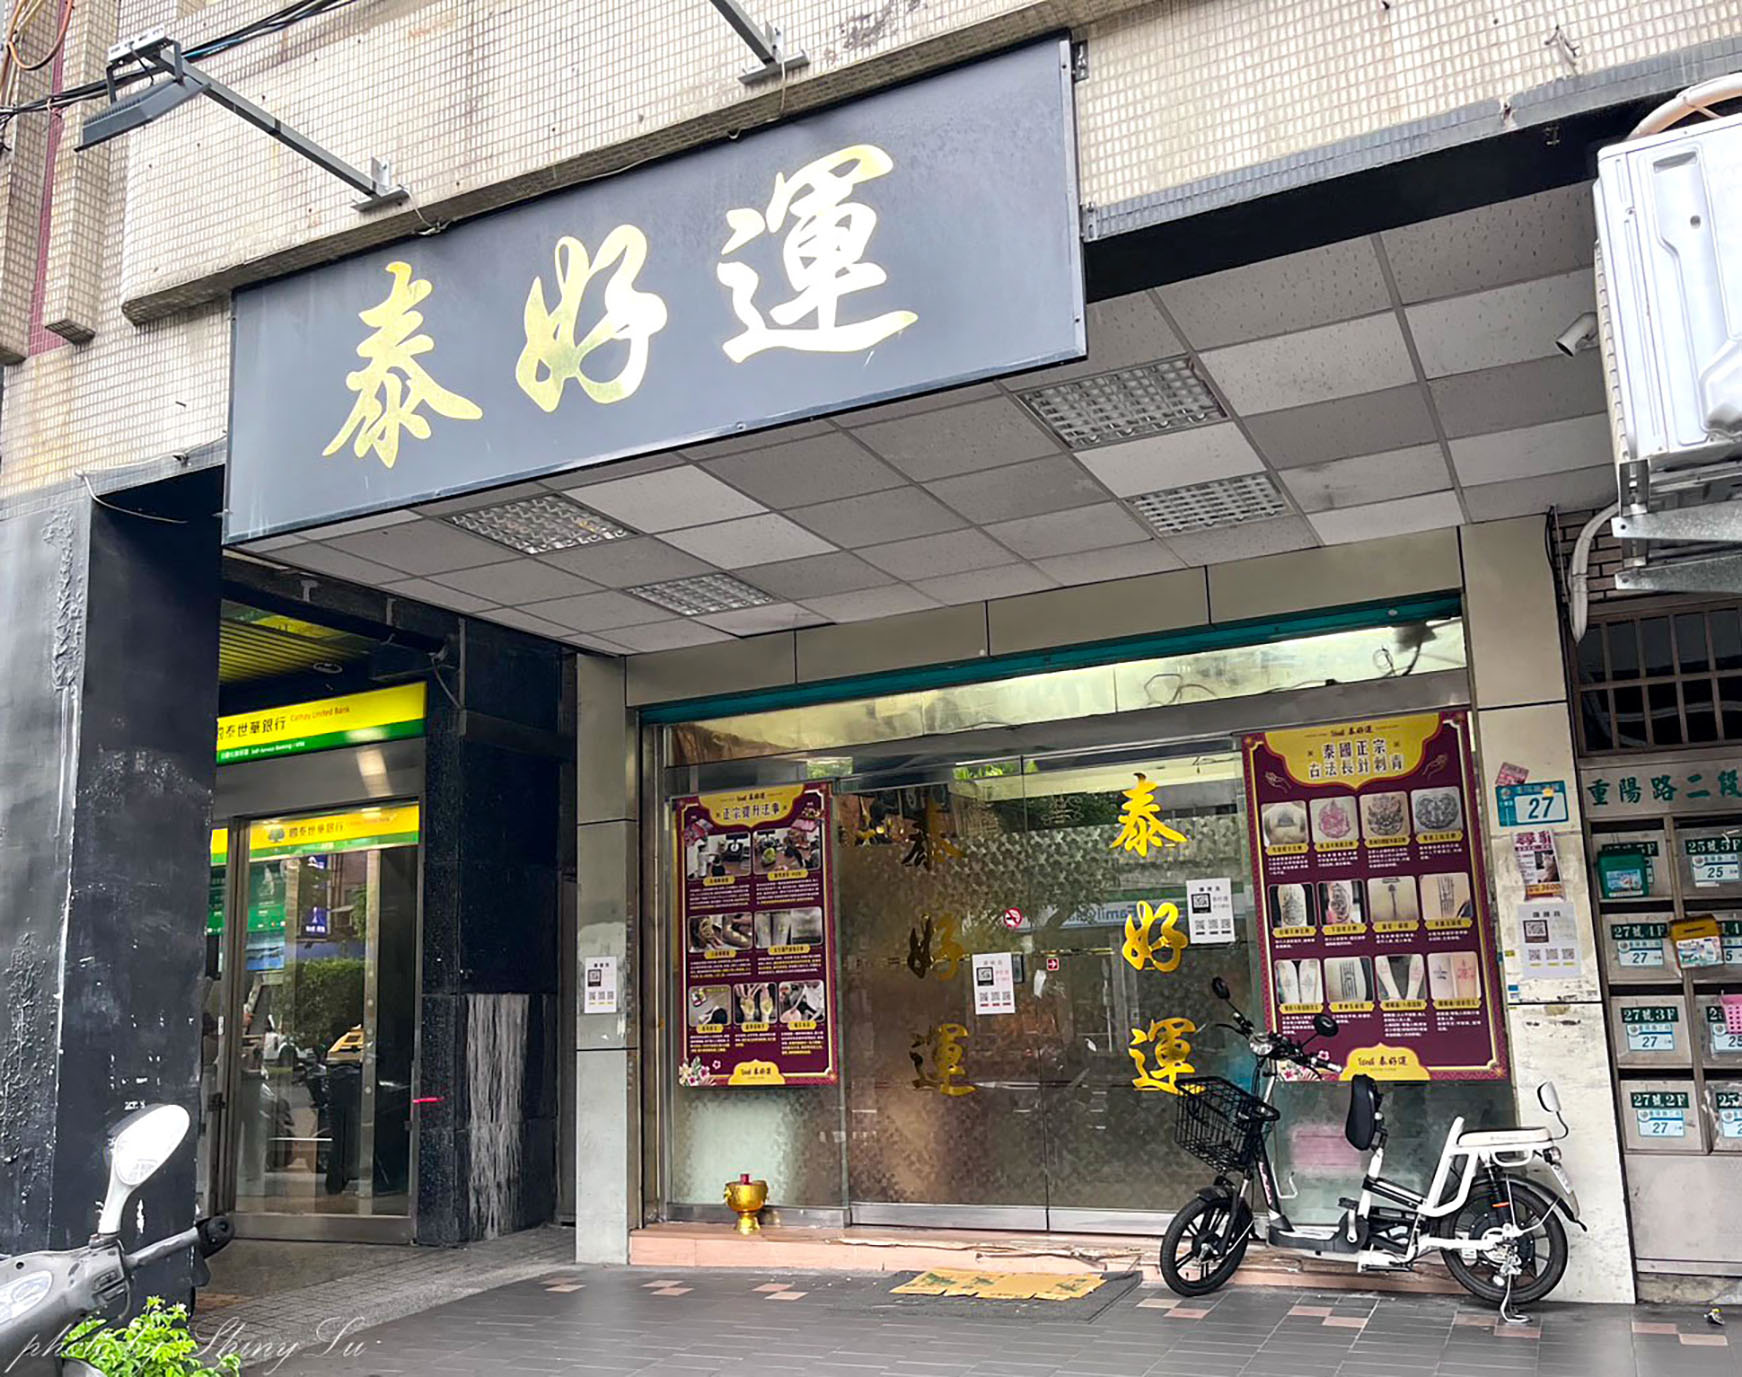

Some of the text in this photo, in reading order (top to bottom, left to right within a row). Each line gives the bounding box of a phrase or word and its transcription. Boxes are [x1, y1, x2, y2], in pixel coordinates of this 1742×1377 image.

[323, 145, 918, 469] 泰好運
[334, 705, 350, 716] Bank
[1324, 739, 1385, 759] 泰國正宗
[1587, 769, 1742, 806] 重陽路二段
[1528, 797, 1554, 819] 27
[1707, 867, 1723, 878] 25
[1112, 773, 1206, 1096] 泰好運
[1632, 952, 1648, 964] 27
[1624, 1008, 1675, 1021] 27號3F
[1642, 1036, 1658, 1048] 27
[1633, 1094, 1686, 1107] 27號2F
[1653, 1122, 1668, 1134] 27
